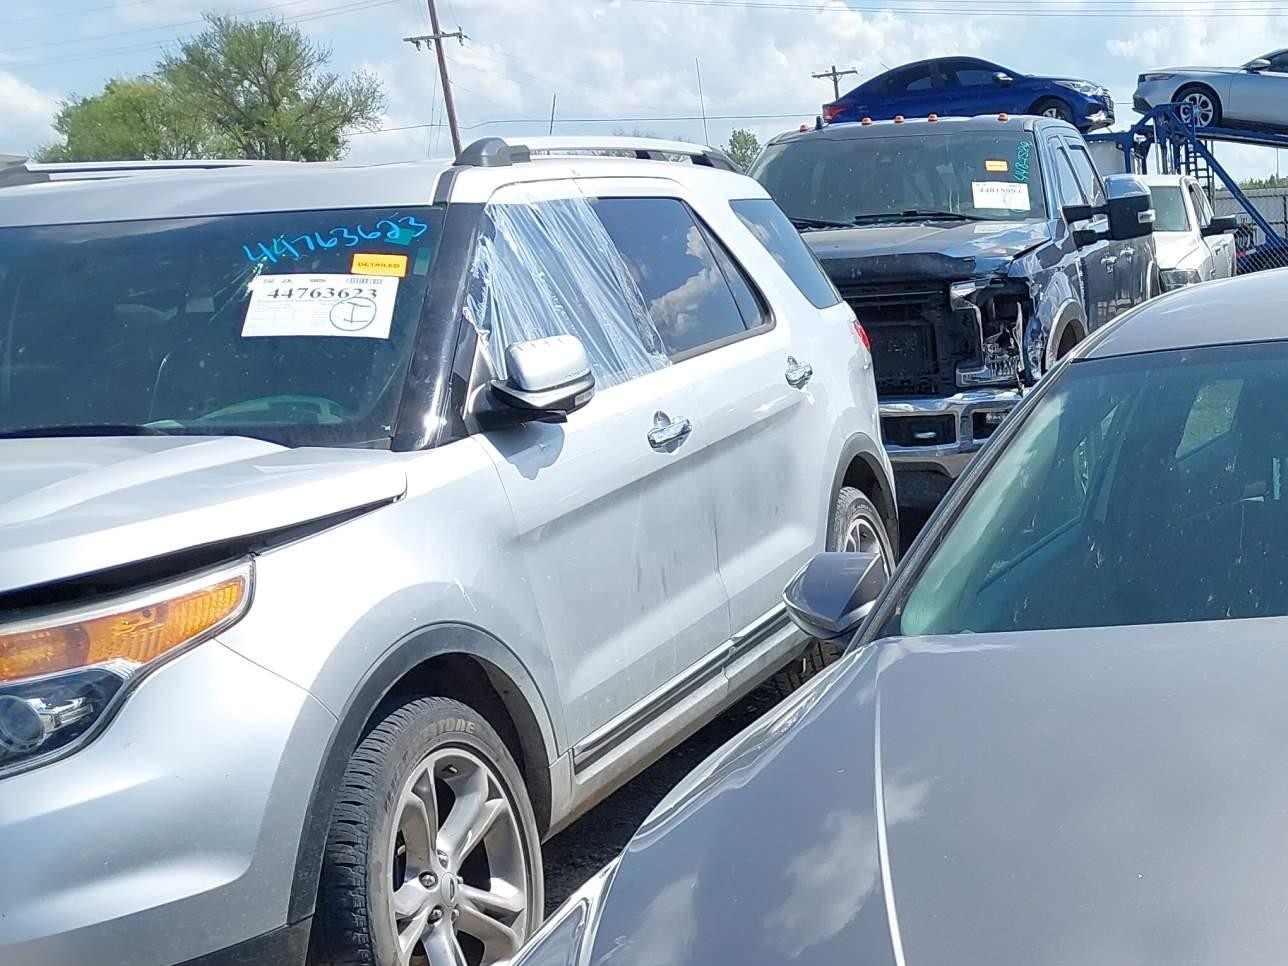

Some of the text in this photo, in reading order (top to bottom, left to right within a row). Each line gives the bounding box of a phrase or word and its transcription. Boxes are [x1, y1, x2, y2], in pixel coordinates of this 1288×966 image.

[241, 213, 427, 263] 44763623
[357, 261, 401, 269] DETAILED
[267, 288, 377, 299] 44763623
